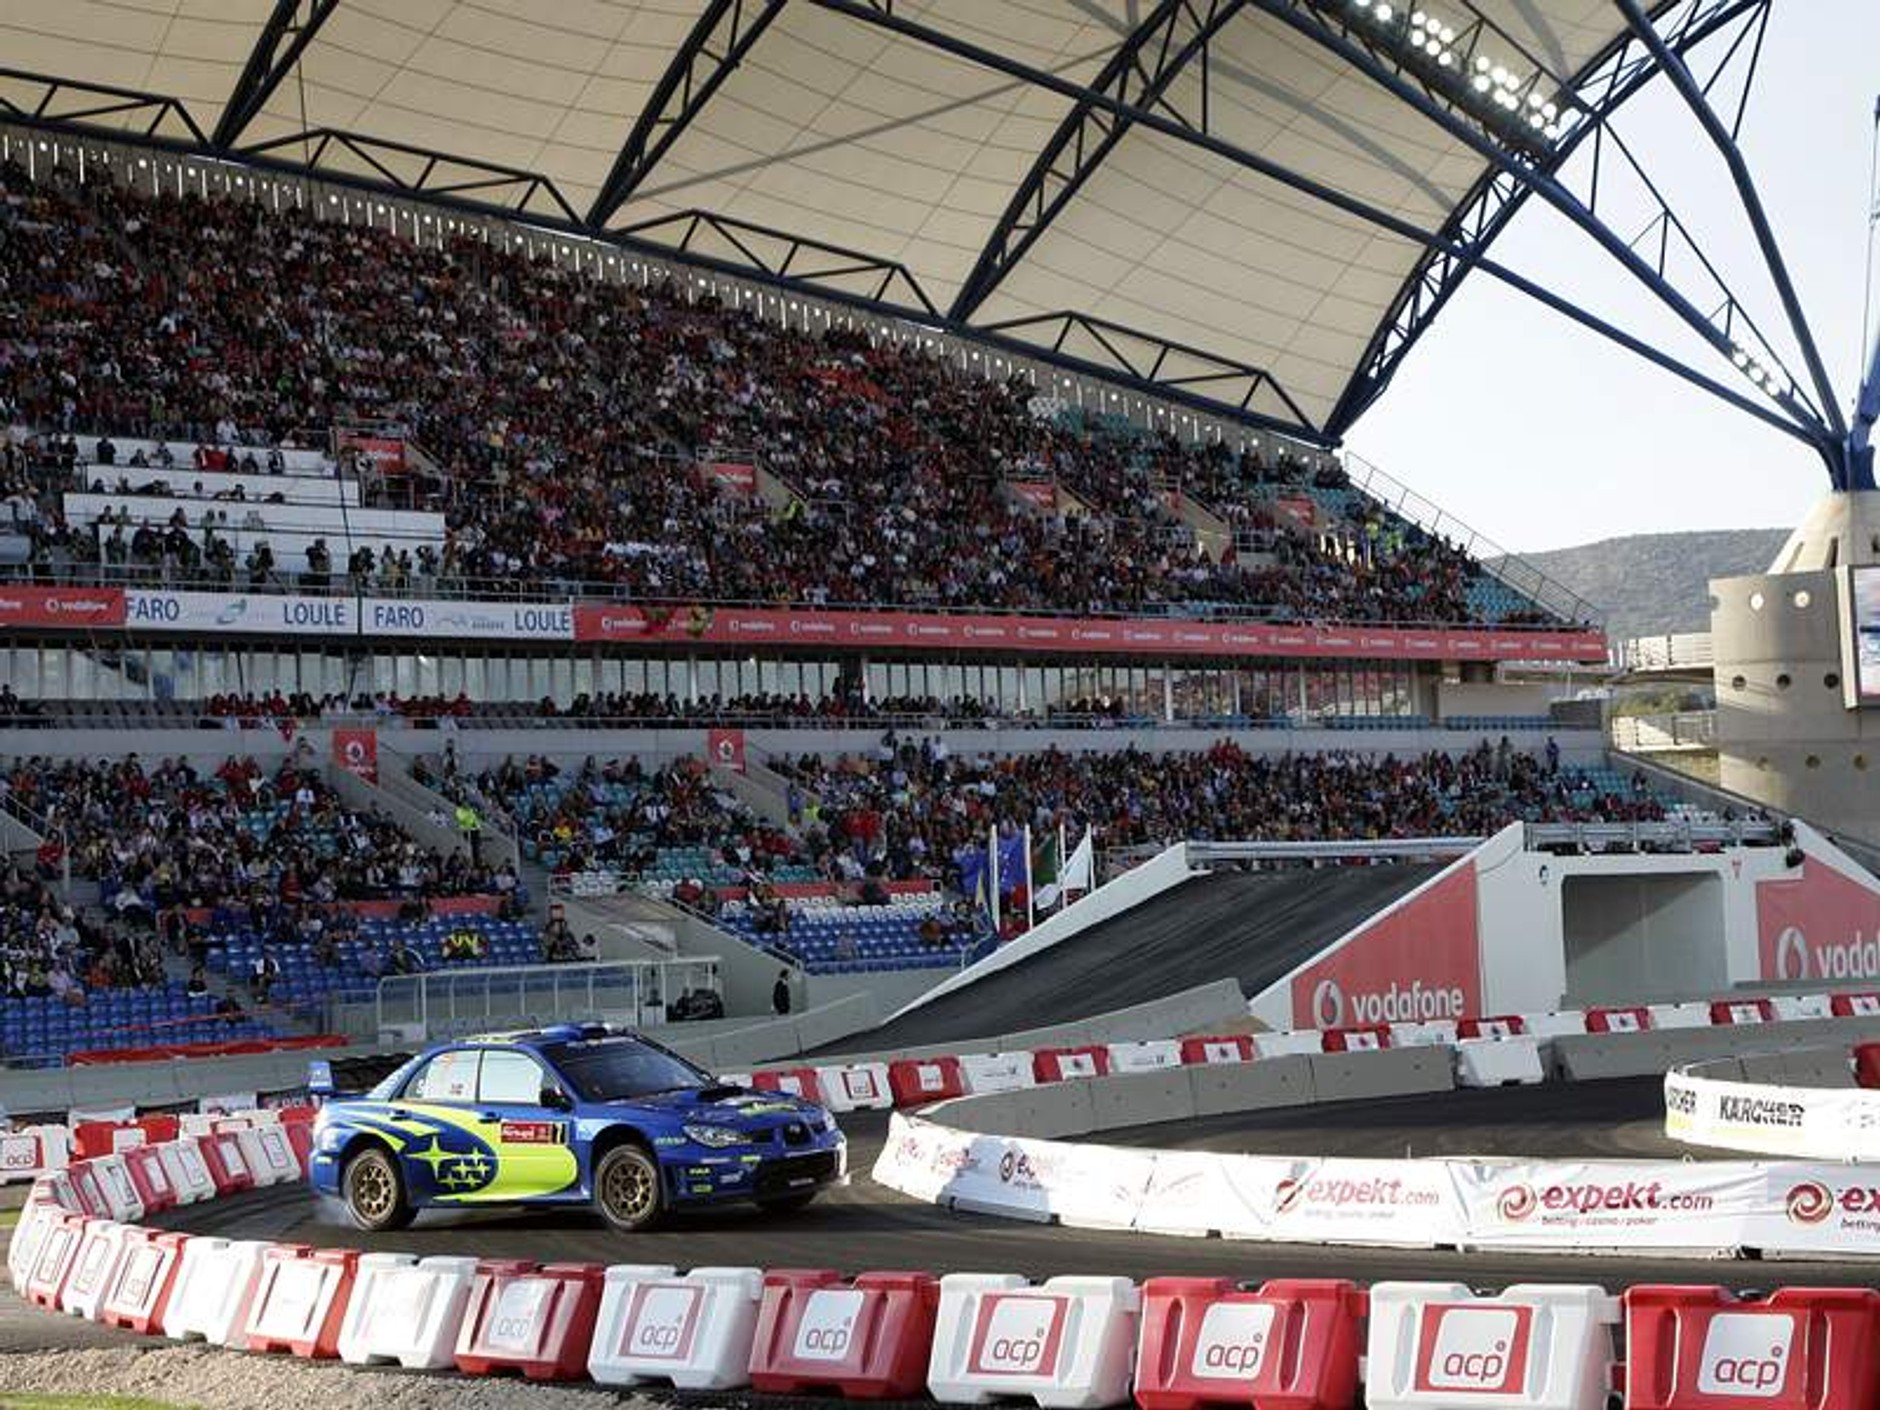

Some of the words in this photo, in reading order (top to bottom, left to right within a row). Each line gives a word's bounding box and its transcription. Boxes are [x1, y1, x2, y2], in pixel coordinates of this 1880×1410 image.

[124, 597, 180, 622] FARO
[374, 605, 425, 629] FARO
[1351, 980, 1464, 1024] vodafone
[1306, 1177, 1440, 1206] expekt.com
[1540, 1182, 1713, 1214] expekt.com
[640, 1325, 678, 1350] acp
[806, 1327, 848, 1355] acp
[993, 1338, 1040, 1367] acp
[1205, 1343, 1259, 1373] acp
[1444, 1353, 1502, 1383] acp
[1715, 1358, 1780, 1389] acp
